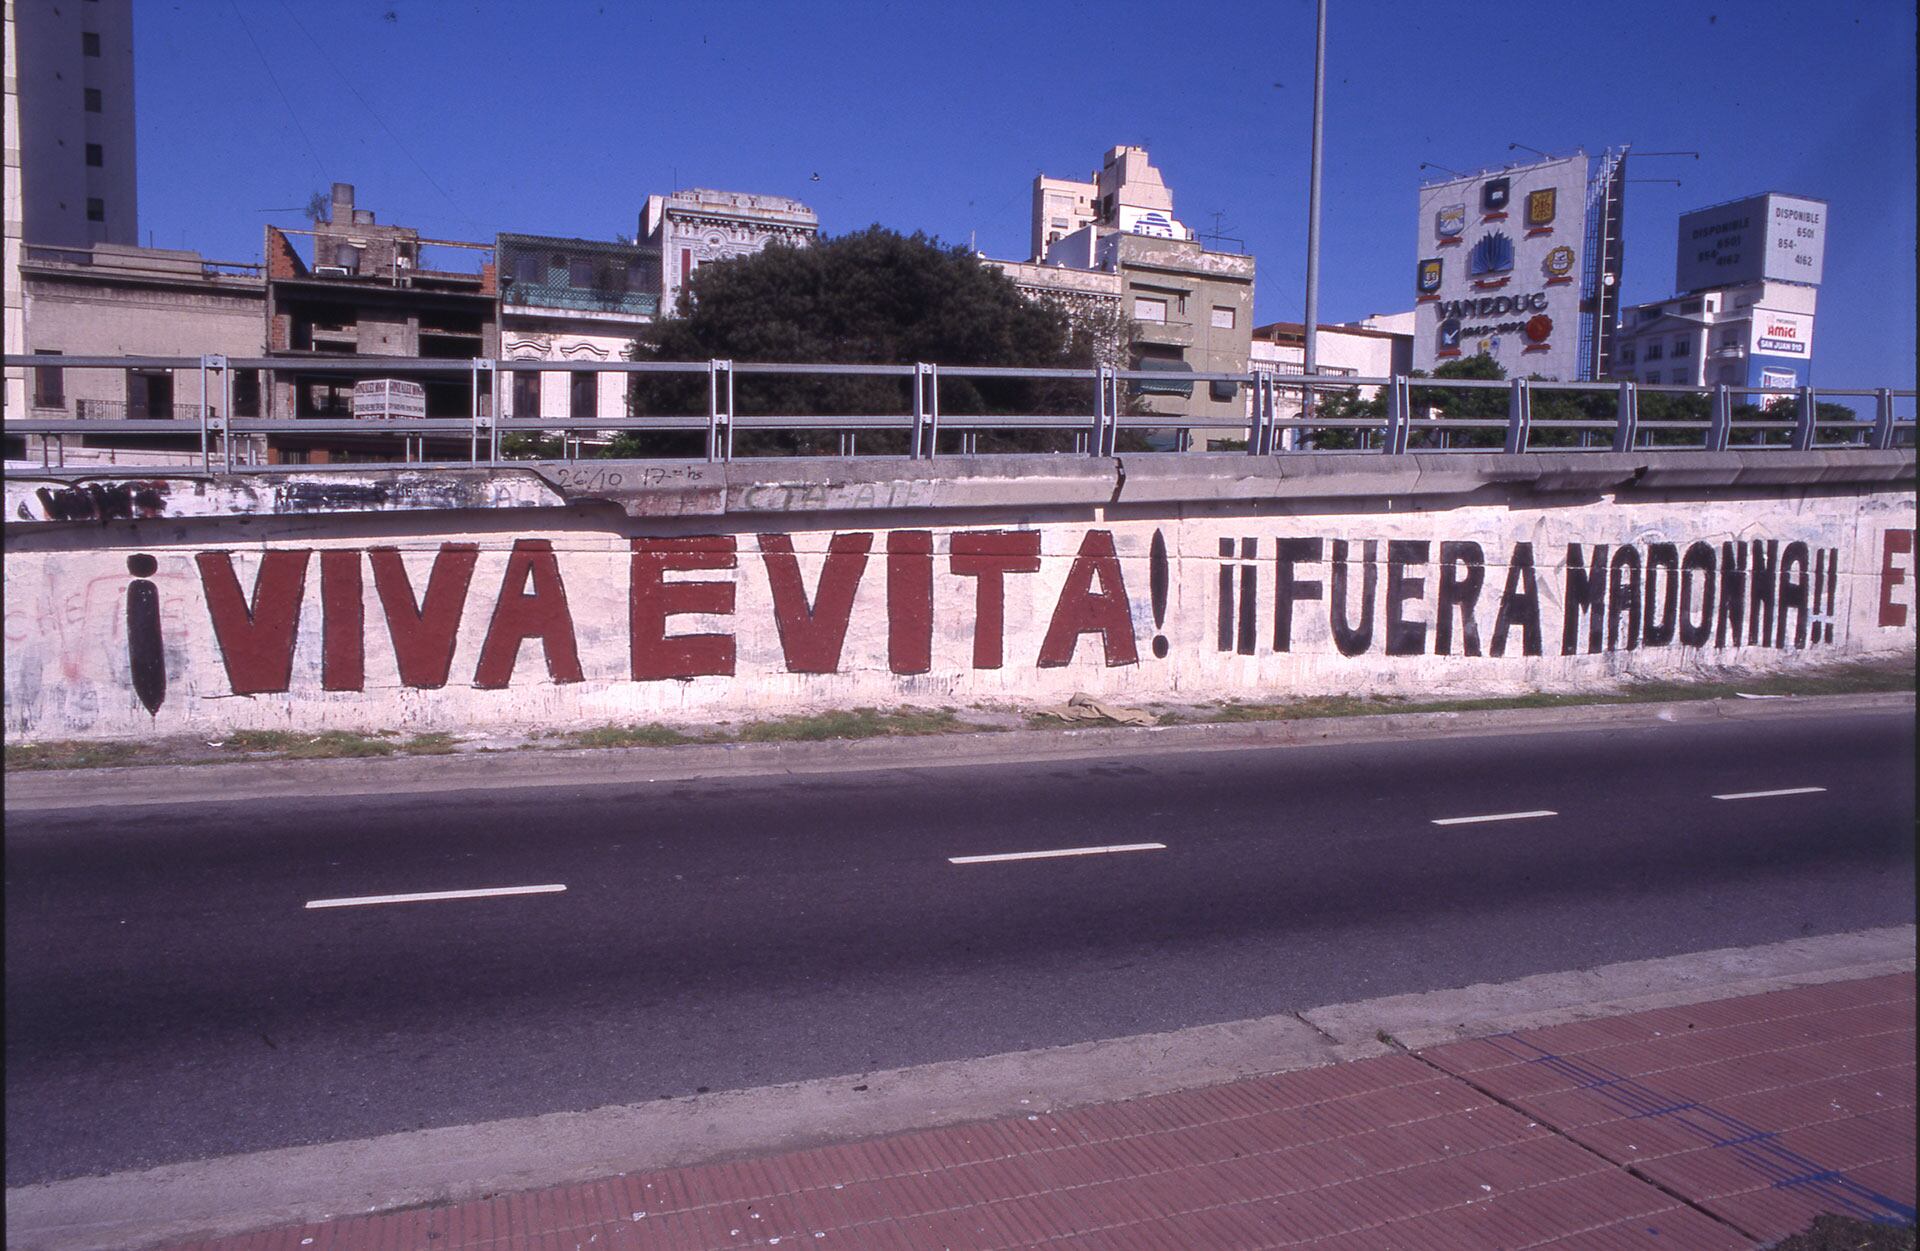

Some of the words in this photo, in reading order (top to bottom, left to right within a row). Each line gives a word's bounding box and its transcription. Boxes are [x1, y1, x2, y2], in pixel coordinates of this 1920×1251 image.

[1775, 207, 1820, 224] DISPONIBLE
[1692, 217, 1750, 240] DISPONIBLE
[1796, 226, 1815, 239] 6501
[1794, 254, 1813, 267] 4162
[1760, 340, 1774, 349] SAN
[1774, 341, 1791, 351] JUAN
[558, 468, 622, 490] 26/10
[629, 527, 1170, 682] EVITA!
[1561, 540, 1839, 655] MADONNA!!
